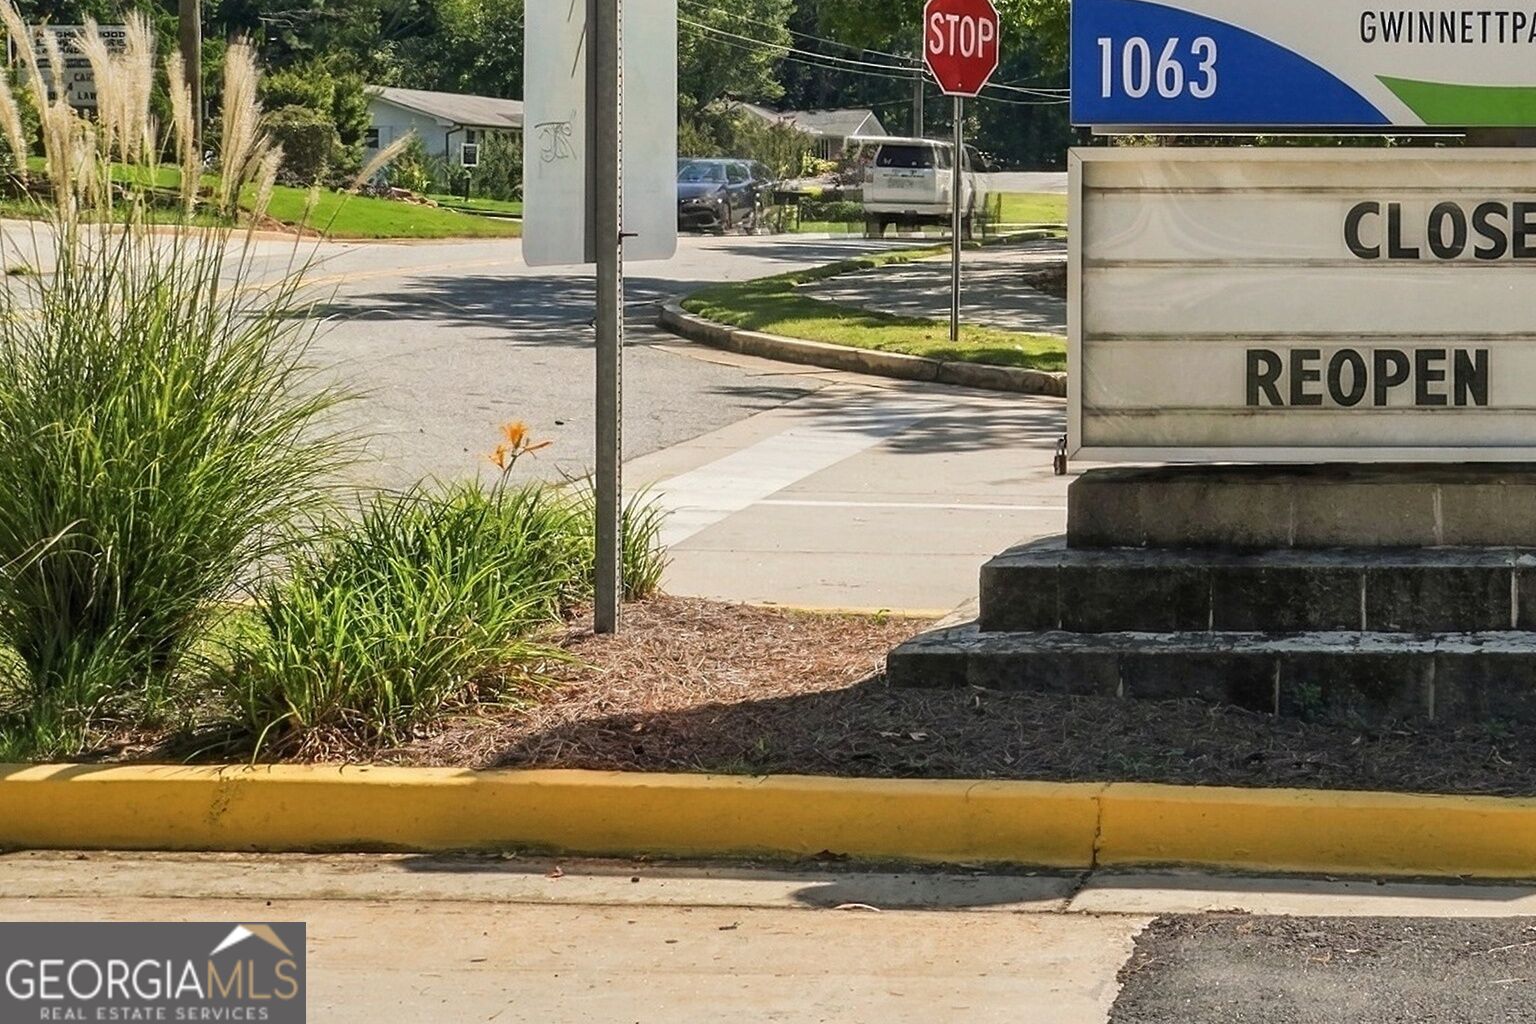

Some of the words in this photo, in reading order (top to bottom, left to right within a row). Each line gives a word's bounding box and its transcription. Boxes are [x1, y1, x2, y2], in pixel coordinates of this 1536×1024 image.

[929, 11, 994, 58] STOP
[1097, 36, 1217, 99] 1063
[1246, 348, 1490, 407] REOPEN
